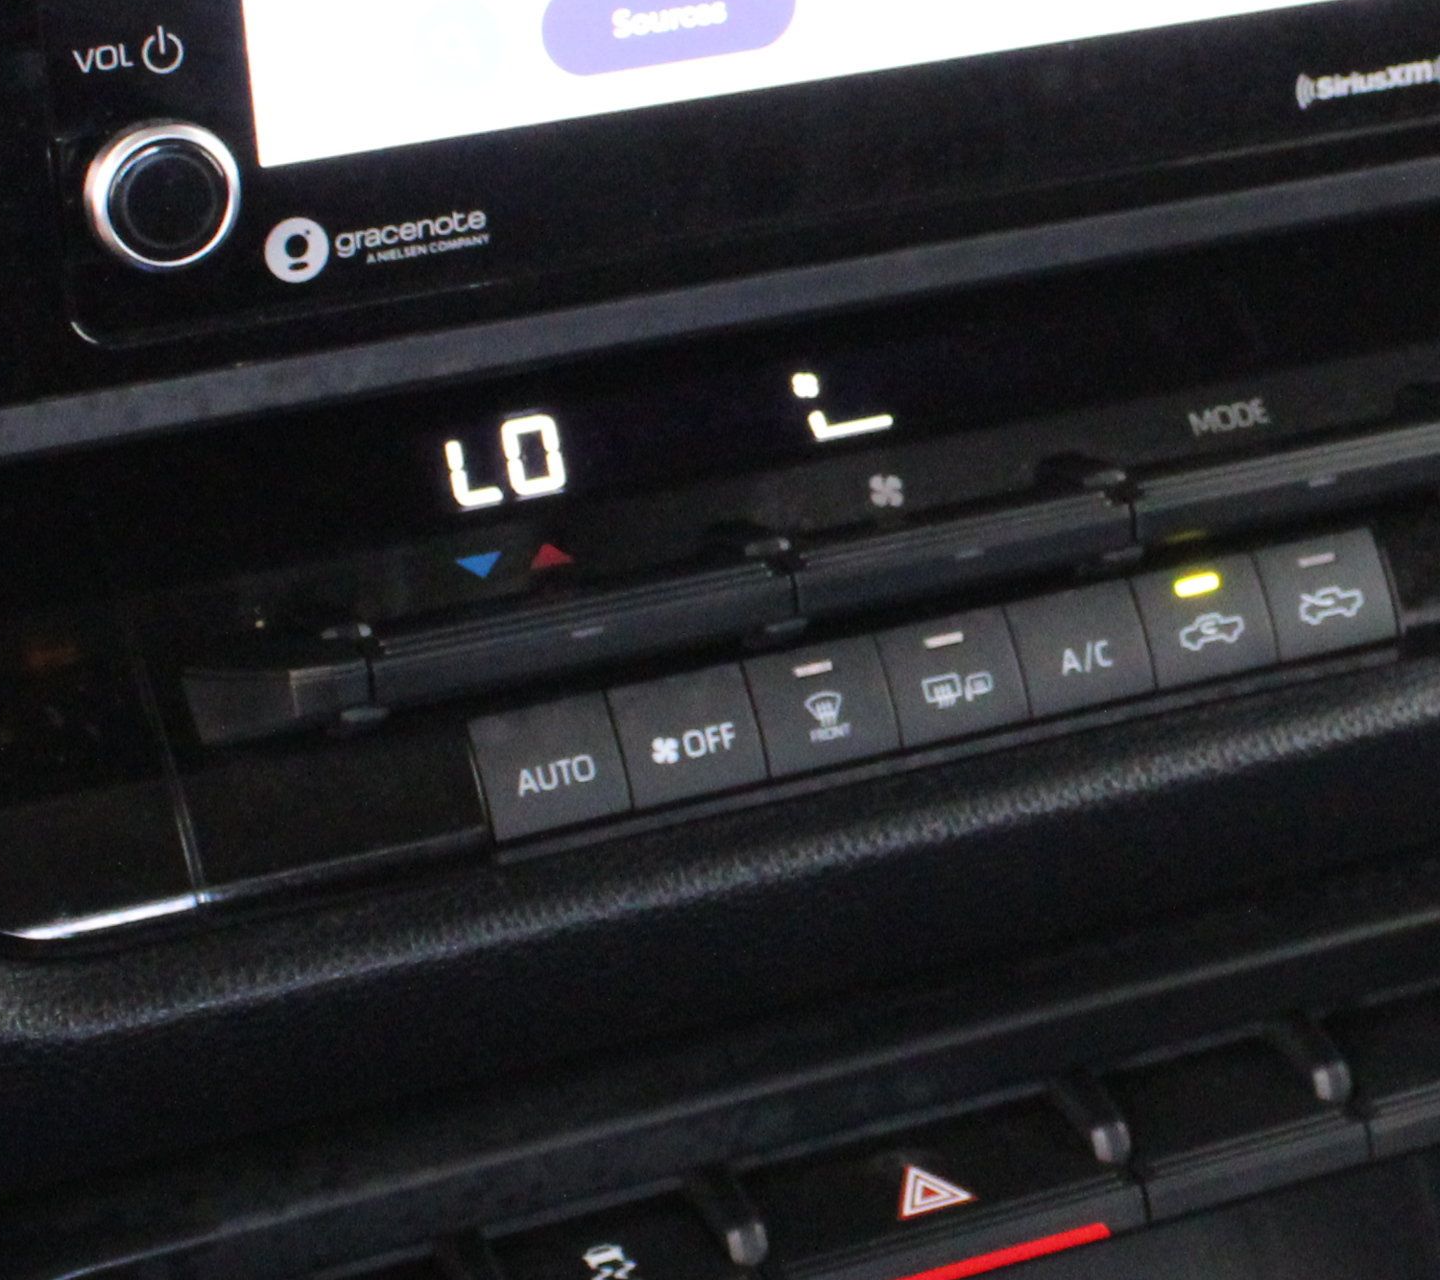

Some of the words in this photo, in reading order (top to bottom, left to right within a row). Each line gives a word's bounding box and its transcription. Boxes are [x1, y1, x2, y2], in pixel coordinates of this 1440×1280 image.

[611, 0, 729, 39] Sources
[72, 42, 133, 74] VOL
[335, 209, 487, 259] gracenote
[377, 245, 428, 263] NIELSEN
[429, 233, 491, 253] COMPANY
[1189, 396, 1272, 438] MODE
[1061, 638, 1114, 677] A/C
[682, 721, 736, 760] OFF
[517, 753, 597, 798] AUTO
